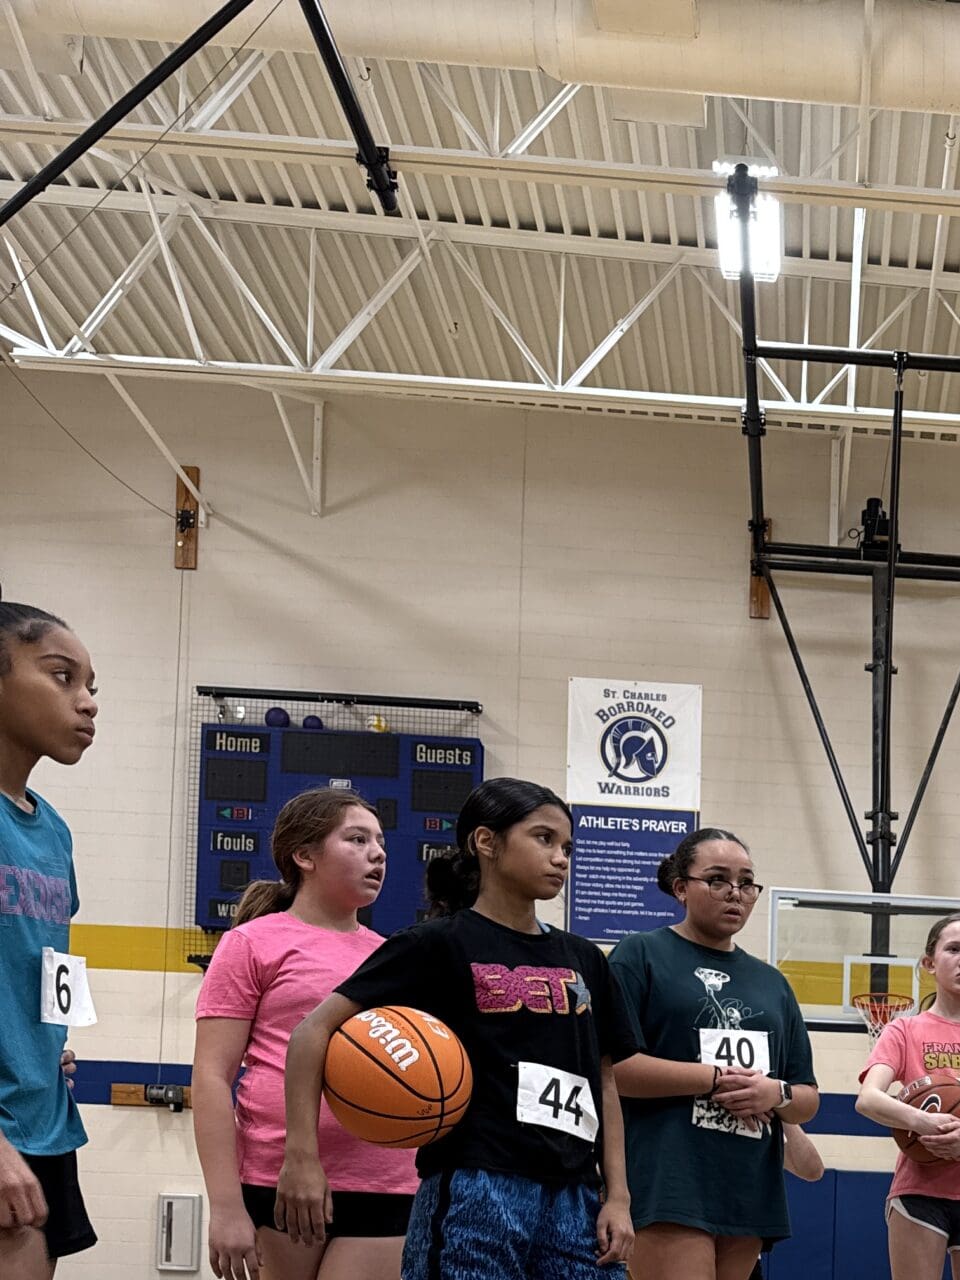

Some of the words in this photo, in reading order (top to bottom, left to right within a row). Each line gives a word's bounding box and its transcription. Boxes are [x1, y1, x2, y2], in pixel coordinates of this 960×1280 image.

[623, 690, 667, 702] CHARLES
[595, 701, 676, 729] BORROMEO
[215, 732, 261, 753] Home
[416, 744, 471, 765] Guests
[597, 782, 670, 798] WARRIORS
[579, 815, 640, 831] ATHLETE'S
[642, 819, 688, 834] PRAYER
[56, 964, 71, 1014] 6
[715, 1037, 755, 1069] 40
[538, 1077, 583, 1126] 44
